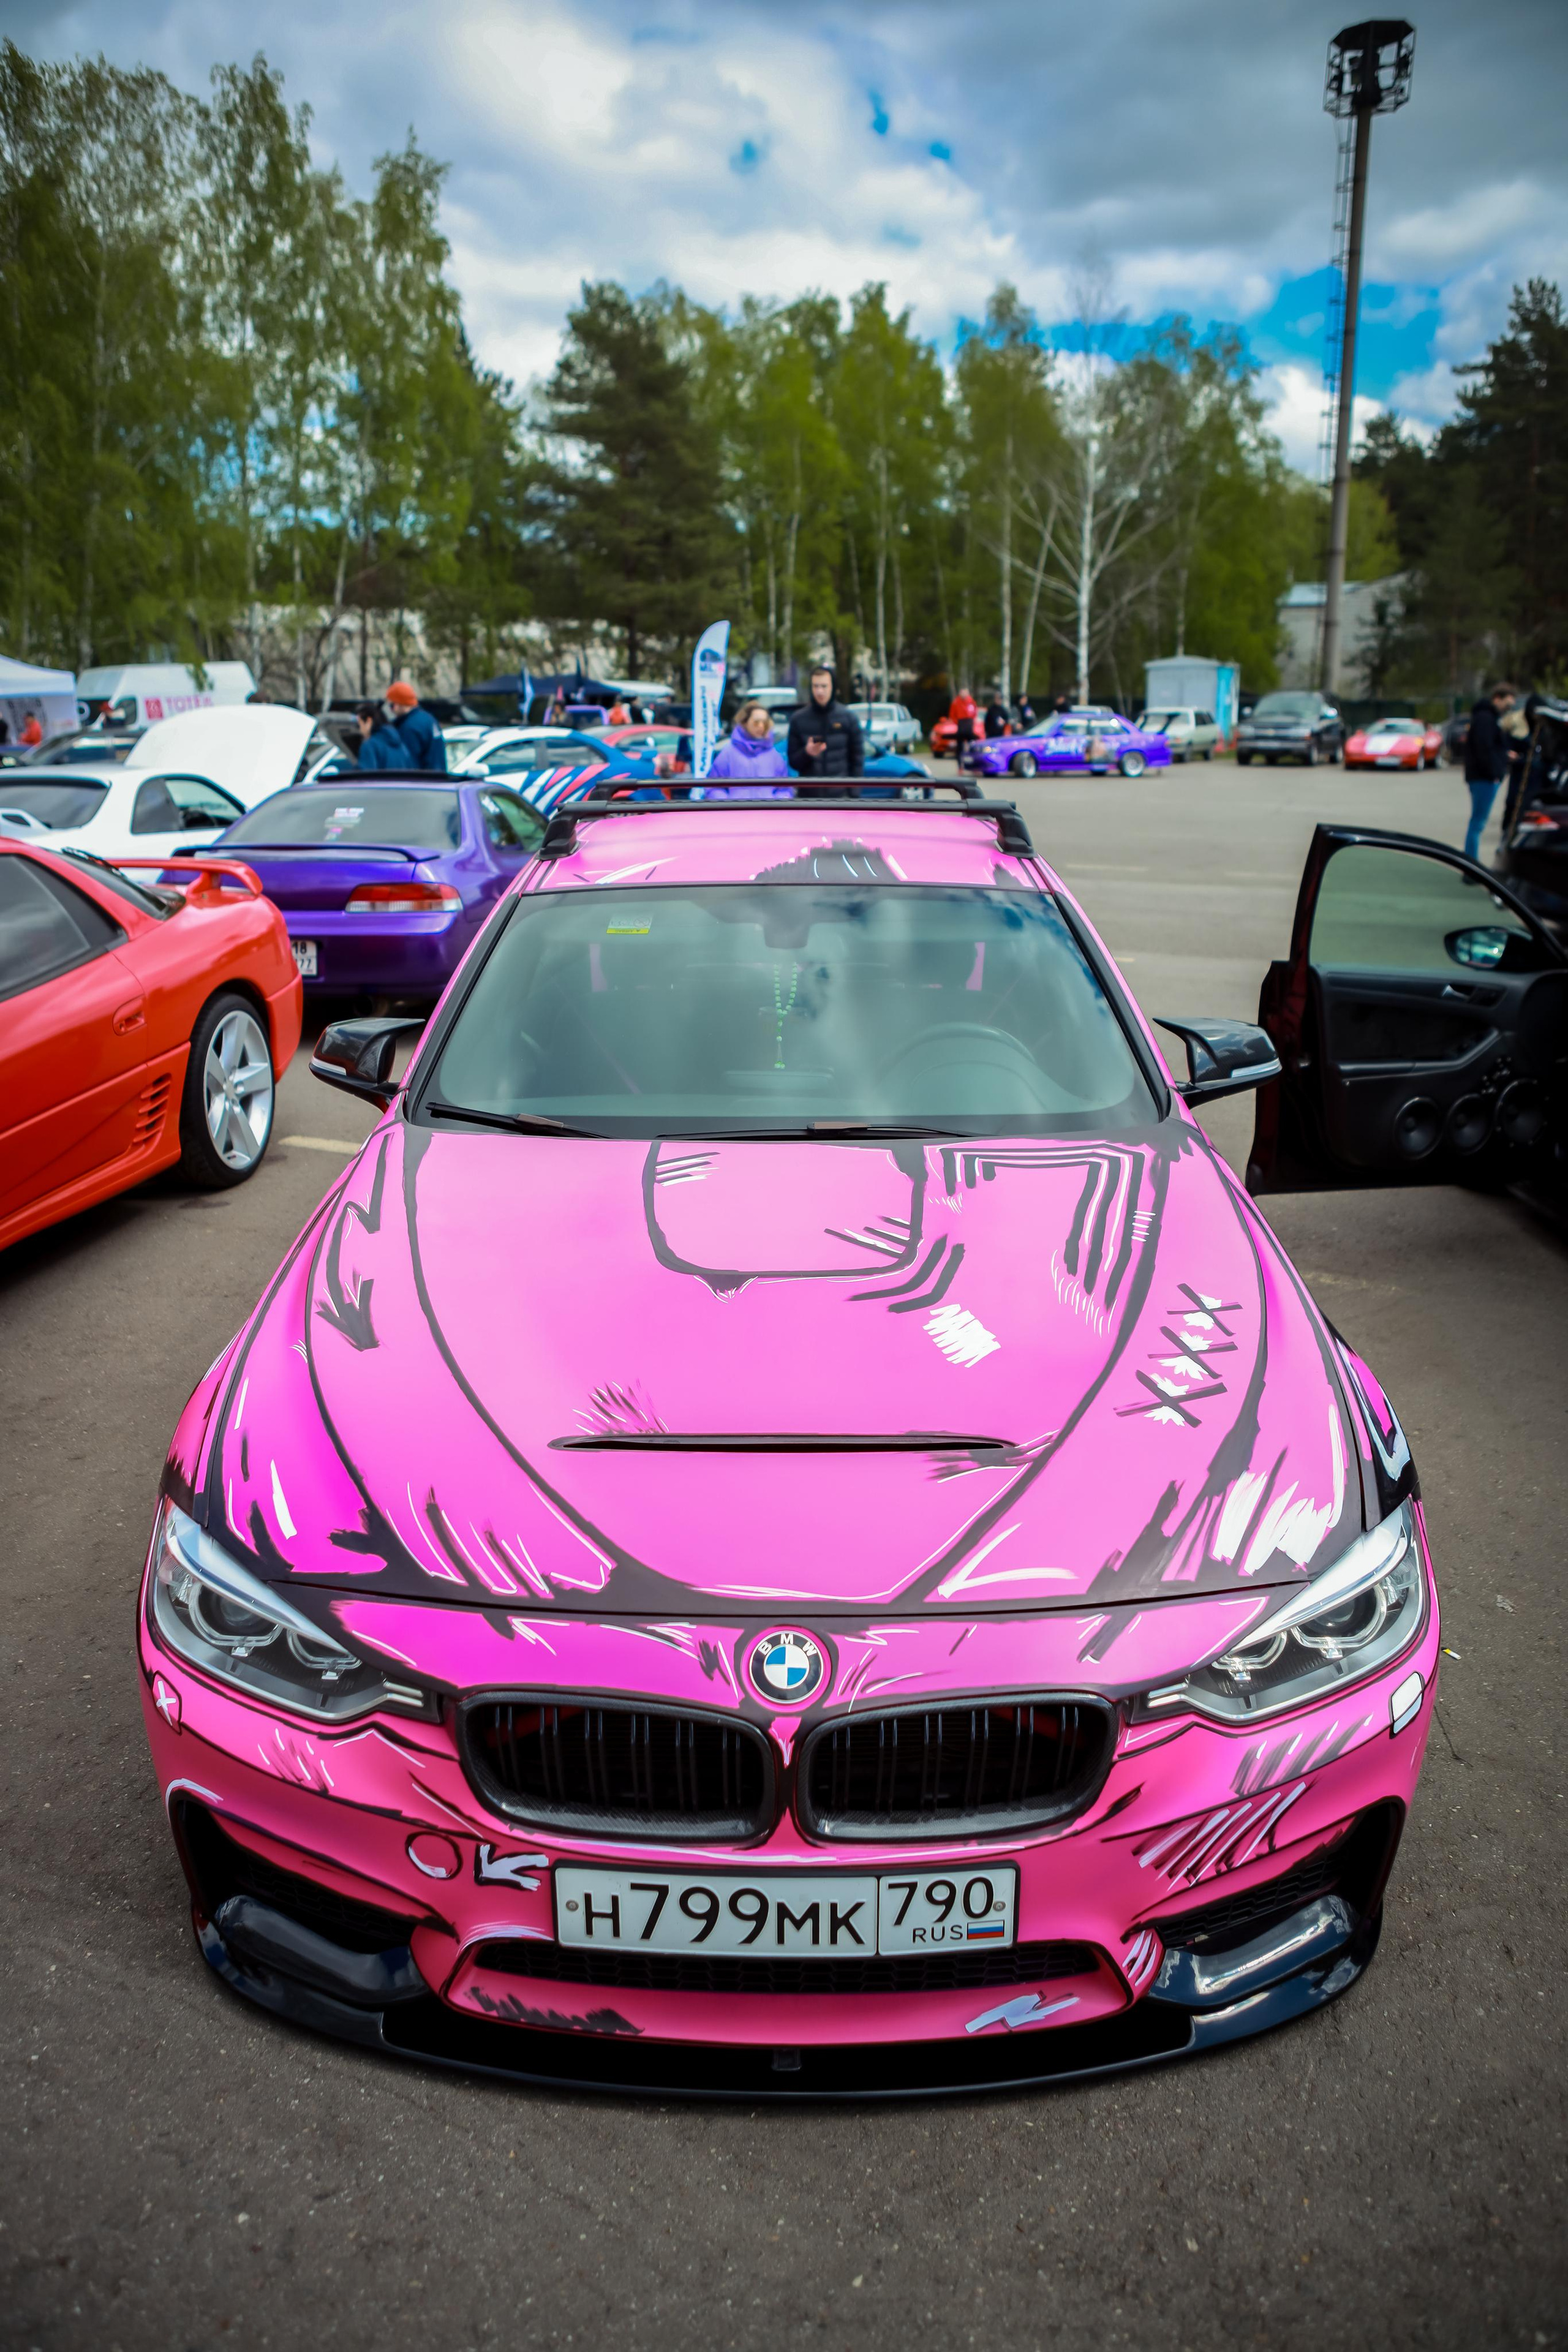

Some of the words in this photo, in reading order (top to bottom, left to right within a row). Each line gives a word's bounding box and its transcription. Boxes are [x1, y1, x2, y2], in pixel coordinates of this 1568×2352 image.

[758, 1633, 818, 1657] BMW
[583, 1882, 866, 1945] H799MK
[887, 1876, 995, 1926] 790
[911, 1924, 963, 1943] RUS
